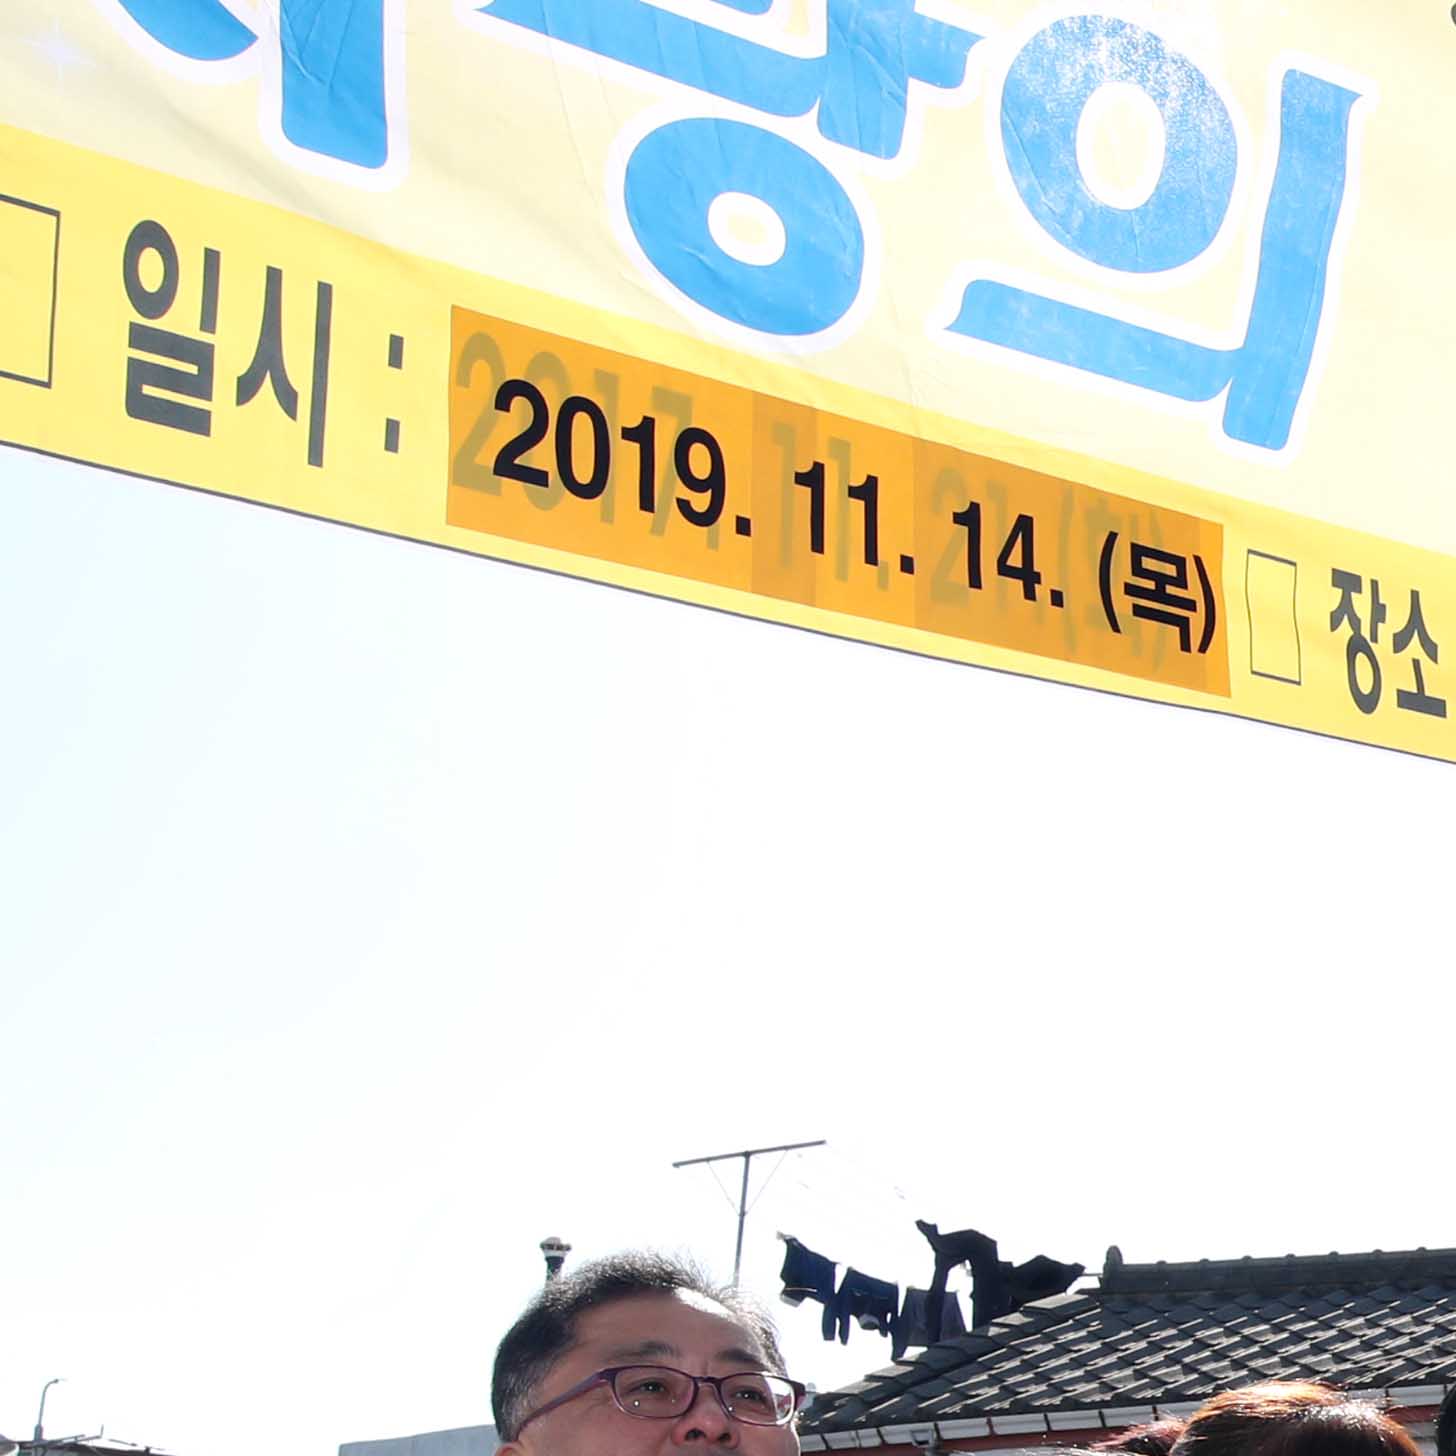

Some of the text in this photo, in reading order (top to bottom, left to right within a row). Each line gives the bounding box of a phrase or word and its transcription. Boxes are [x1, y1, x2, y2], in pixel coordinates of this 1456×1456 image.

[123, 219, 332, 468] 일시
[493, 380, 751, 537] 2019.
[793, 462, 914, 575] 11.
[1329, 569, 1447, 715] 장소
